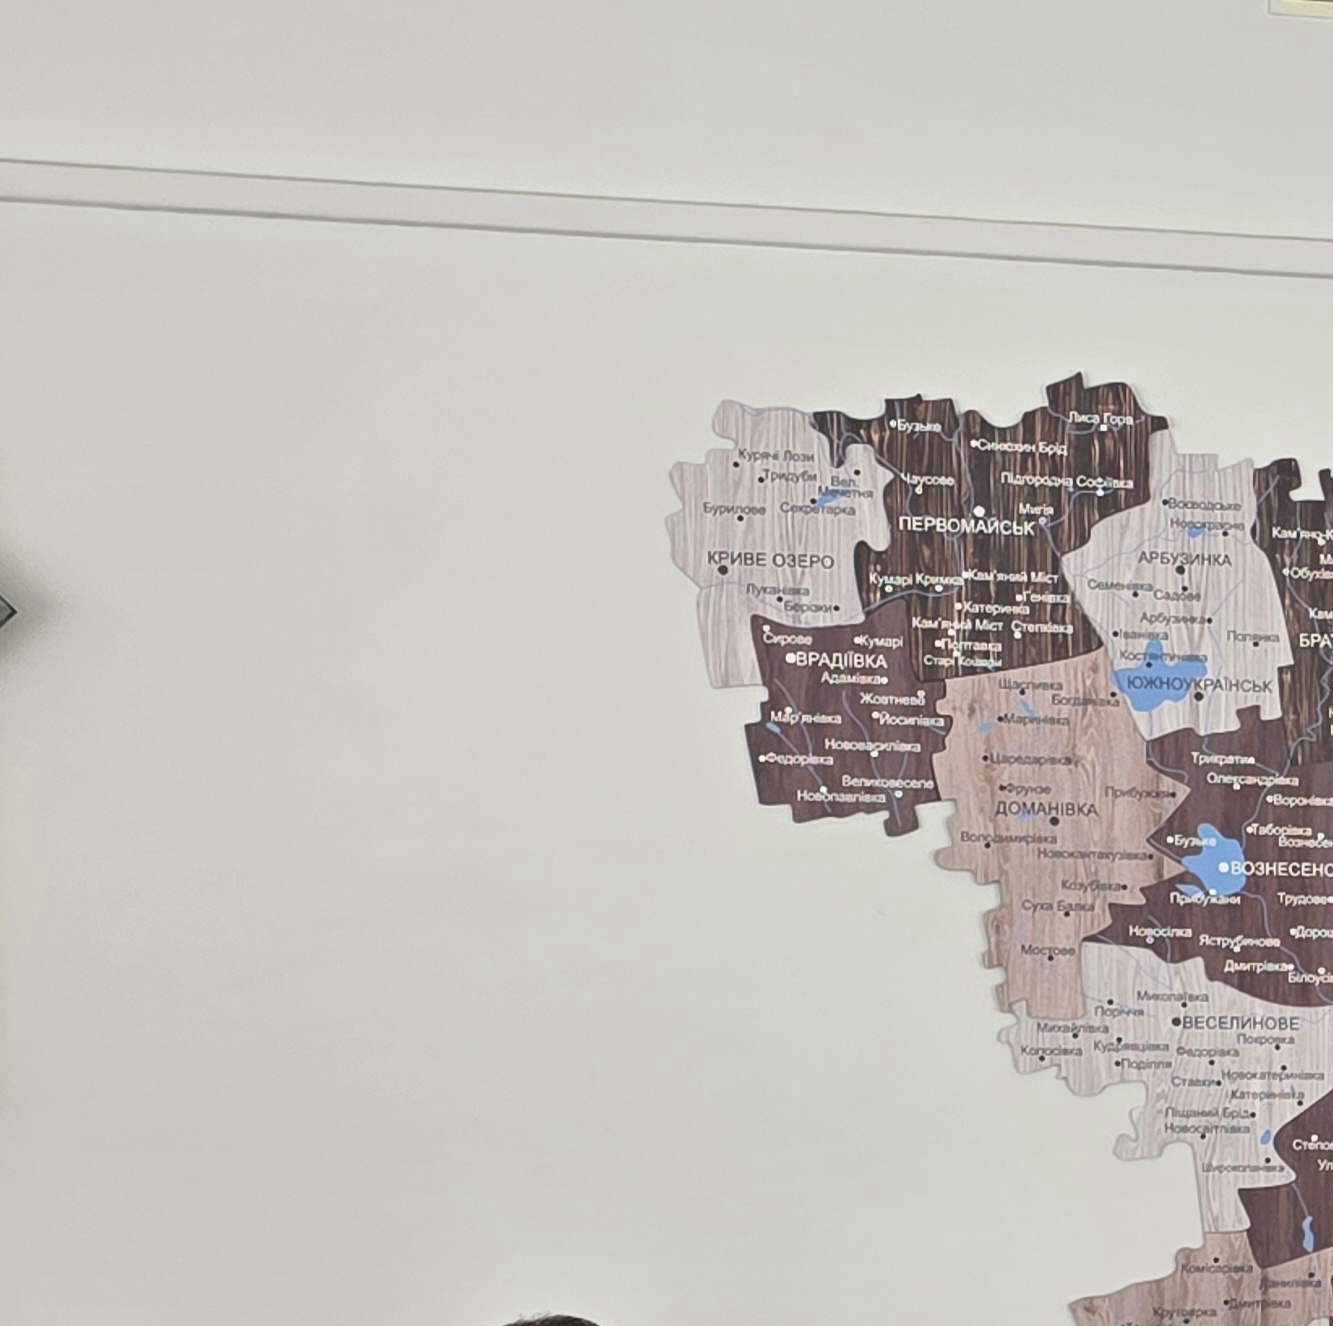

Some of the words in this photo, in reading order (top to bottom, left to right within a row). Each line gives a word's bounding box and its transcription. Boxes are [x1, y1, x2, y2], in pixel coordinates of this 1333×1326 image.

[900, 517, 1035, 535] ПЕРВОМАЙСЬК
[708, 551, 766, 567] КРИВЕ
[773, 552, 834, 569] ОЗЕРО
[1138, 551, 1231, 567] АРБУЗИНКА
[796, 651, 887, 669] ВРАДІЇВКА
[1127, 674, 1271, 694] ЮЖНОУКРАЇНСЬК
[996, 801, 1097, 817] ДОМАНІВКА
[1183, 1015, 1300, 1031] ВЕСЕЛИНОВЕ
